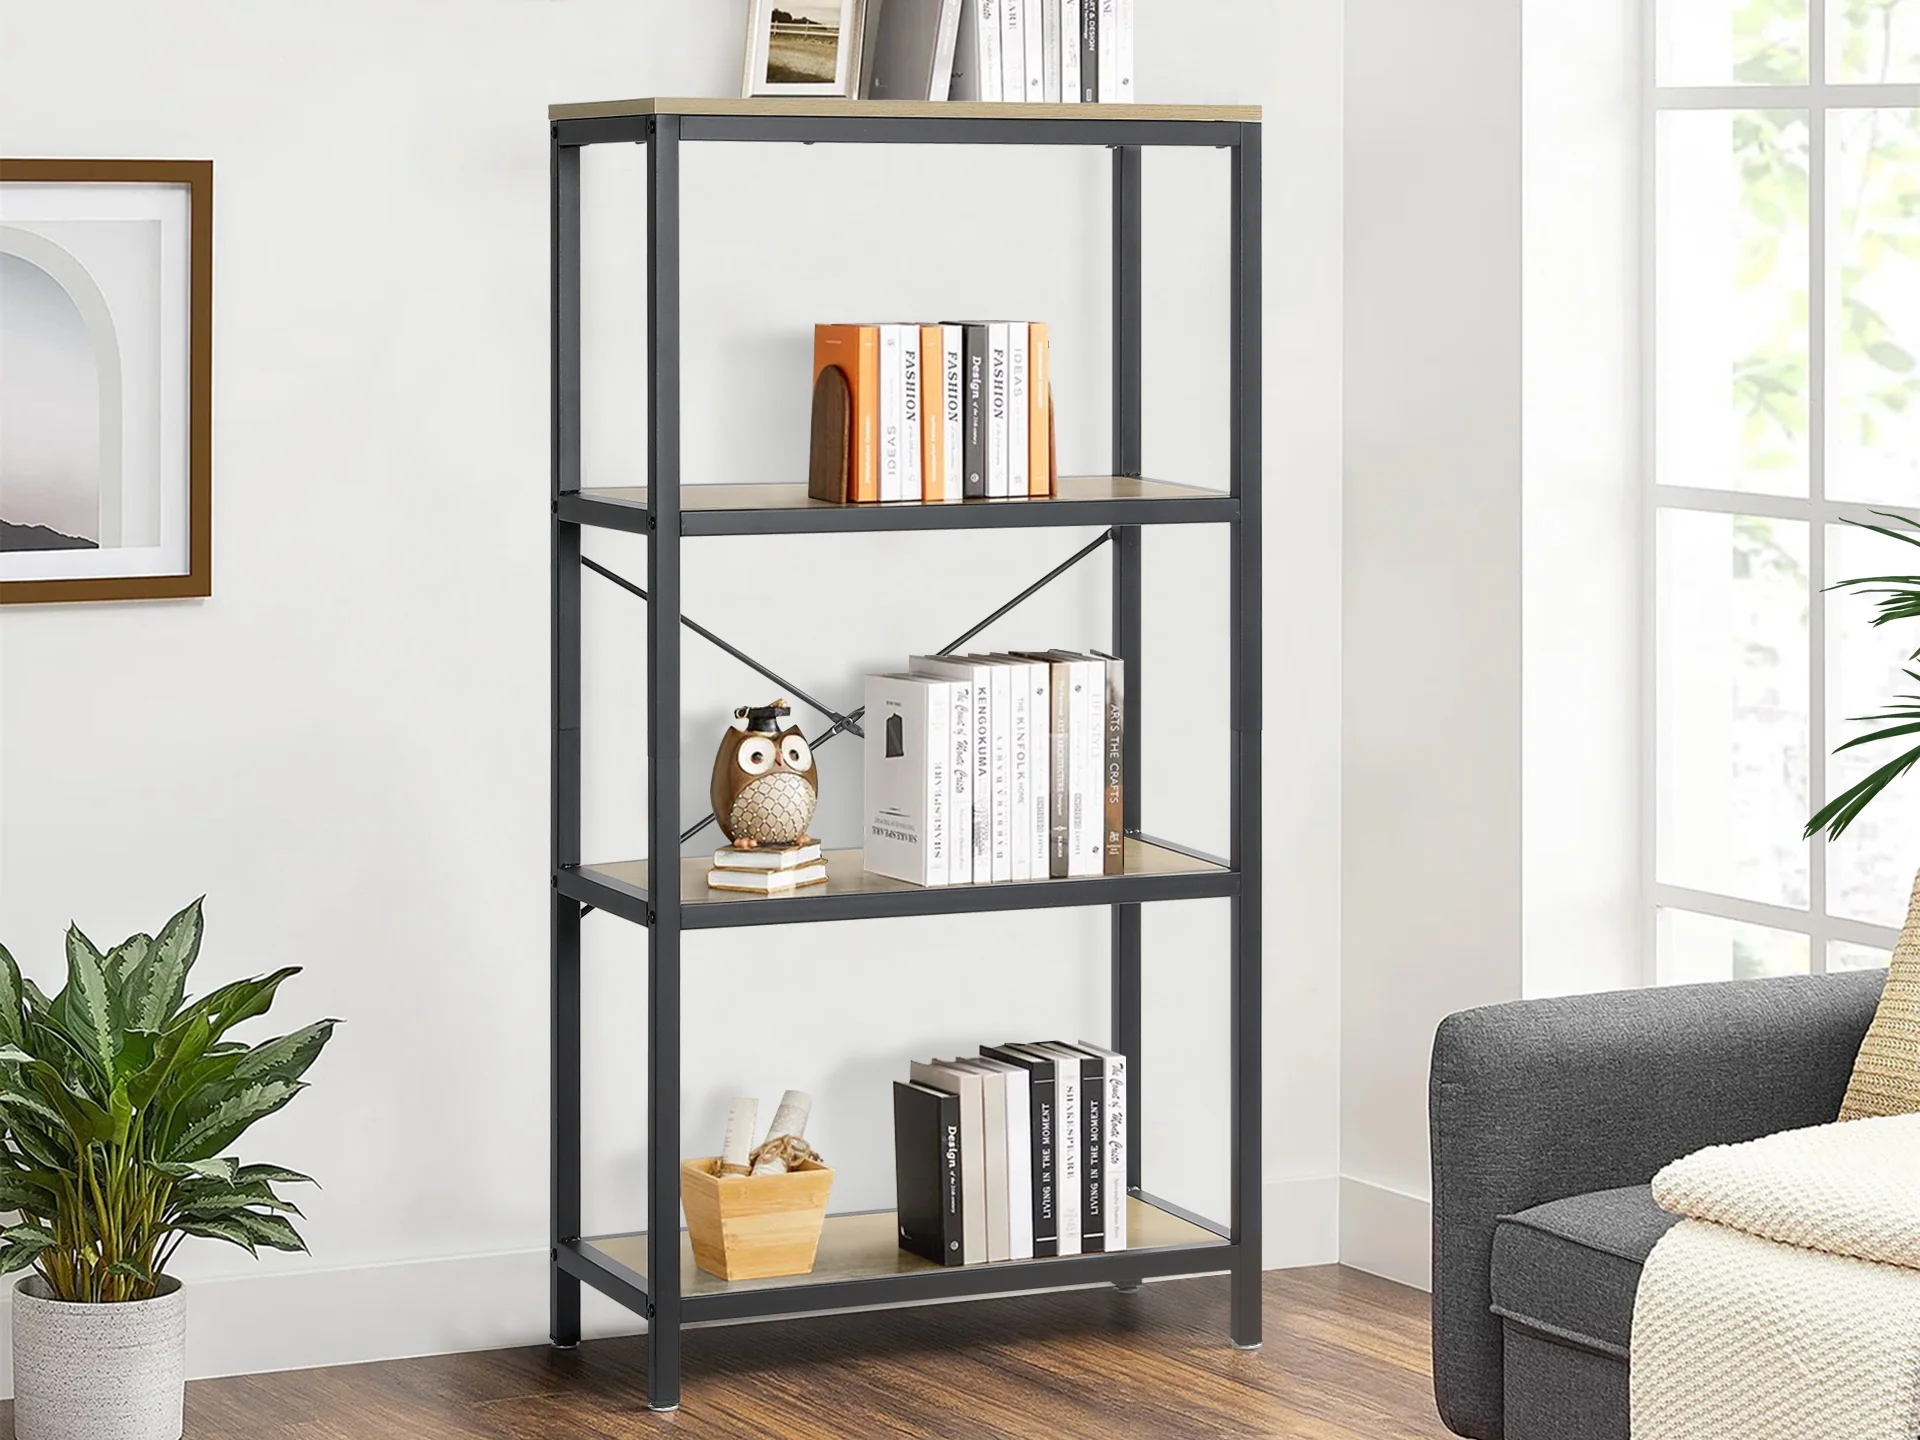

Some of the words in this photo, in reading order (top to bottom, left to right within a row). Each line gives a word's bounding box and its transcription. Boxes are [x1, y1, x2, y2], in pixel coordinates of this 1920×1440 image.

[1088, 20, 1096, 51] DESIGN
[905, 350, 916, 422] FASHION
[947, 351, 958, 423] FASHION
[969, 355, 982, 400] Design
[993, 348, 1004, 420] FASHION
[1013, 348, 1023, 398] IDEAS
[887, 425, 897, 476] IDEAS
[977, 686, 988, 777] KENGOKUMA
[1110, 703, 1120, 732] ARTS
[1016, 716, 1026, 780] KINFOLK
[1110, 736, 1119, 759] THE
[1109, 762, 1119, 804] CRAFTS
[934, 762, 942, 858] SHAKESPEARE
[871, 825, 918, 844] SHAKESPEARE
[1112, 1063, 1124, 1077] The
[1041, 1103, 1051, 1144] MOMENT
[1066, 1085, 1075, 1179] SHAKESPEARE
[1090, 1100, 1099, 1141] MOMENT
[946, 1125, 958, 1168] Design
[1042, 1149, 1051, 1168] THE
[1090, 1145, 1099, 1164] THE
[1042, 1173, 1050, 1182] IN
[1090, 1169, 1099, 1178] IN
[1042, 1187, 1051, 1219] LIVING
[1089, 1183, 1099, 1216] LIVING
